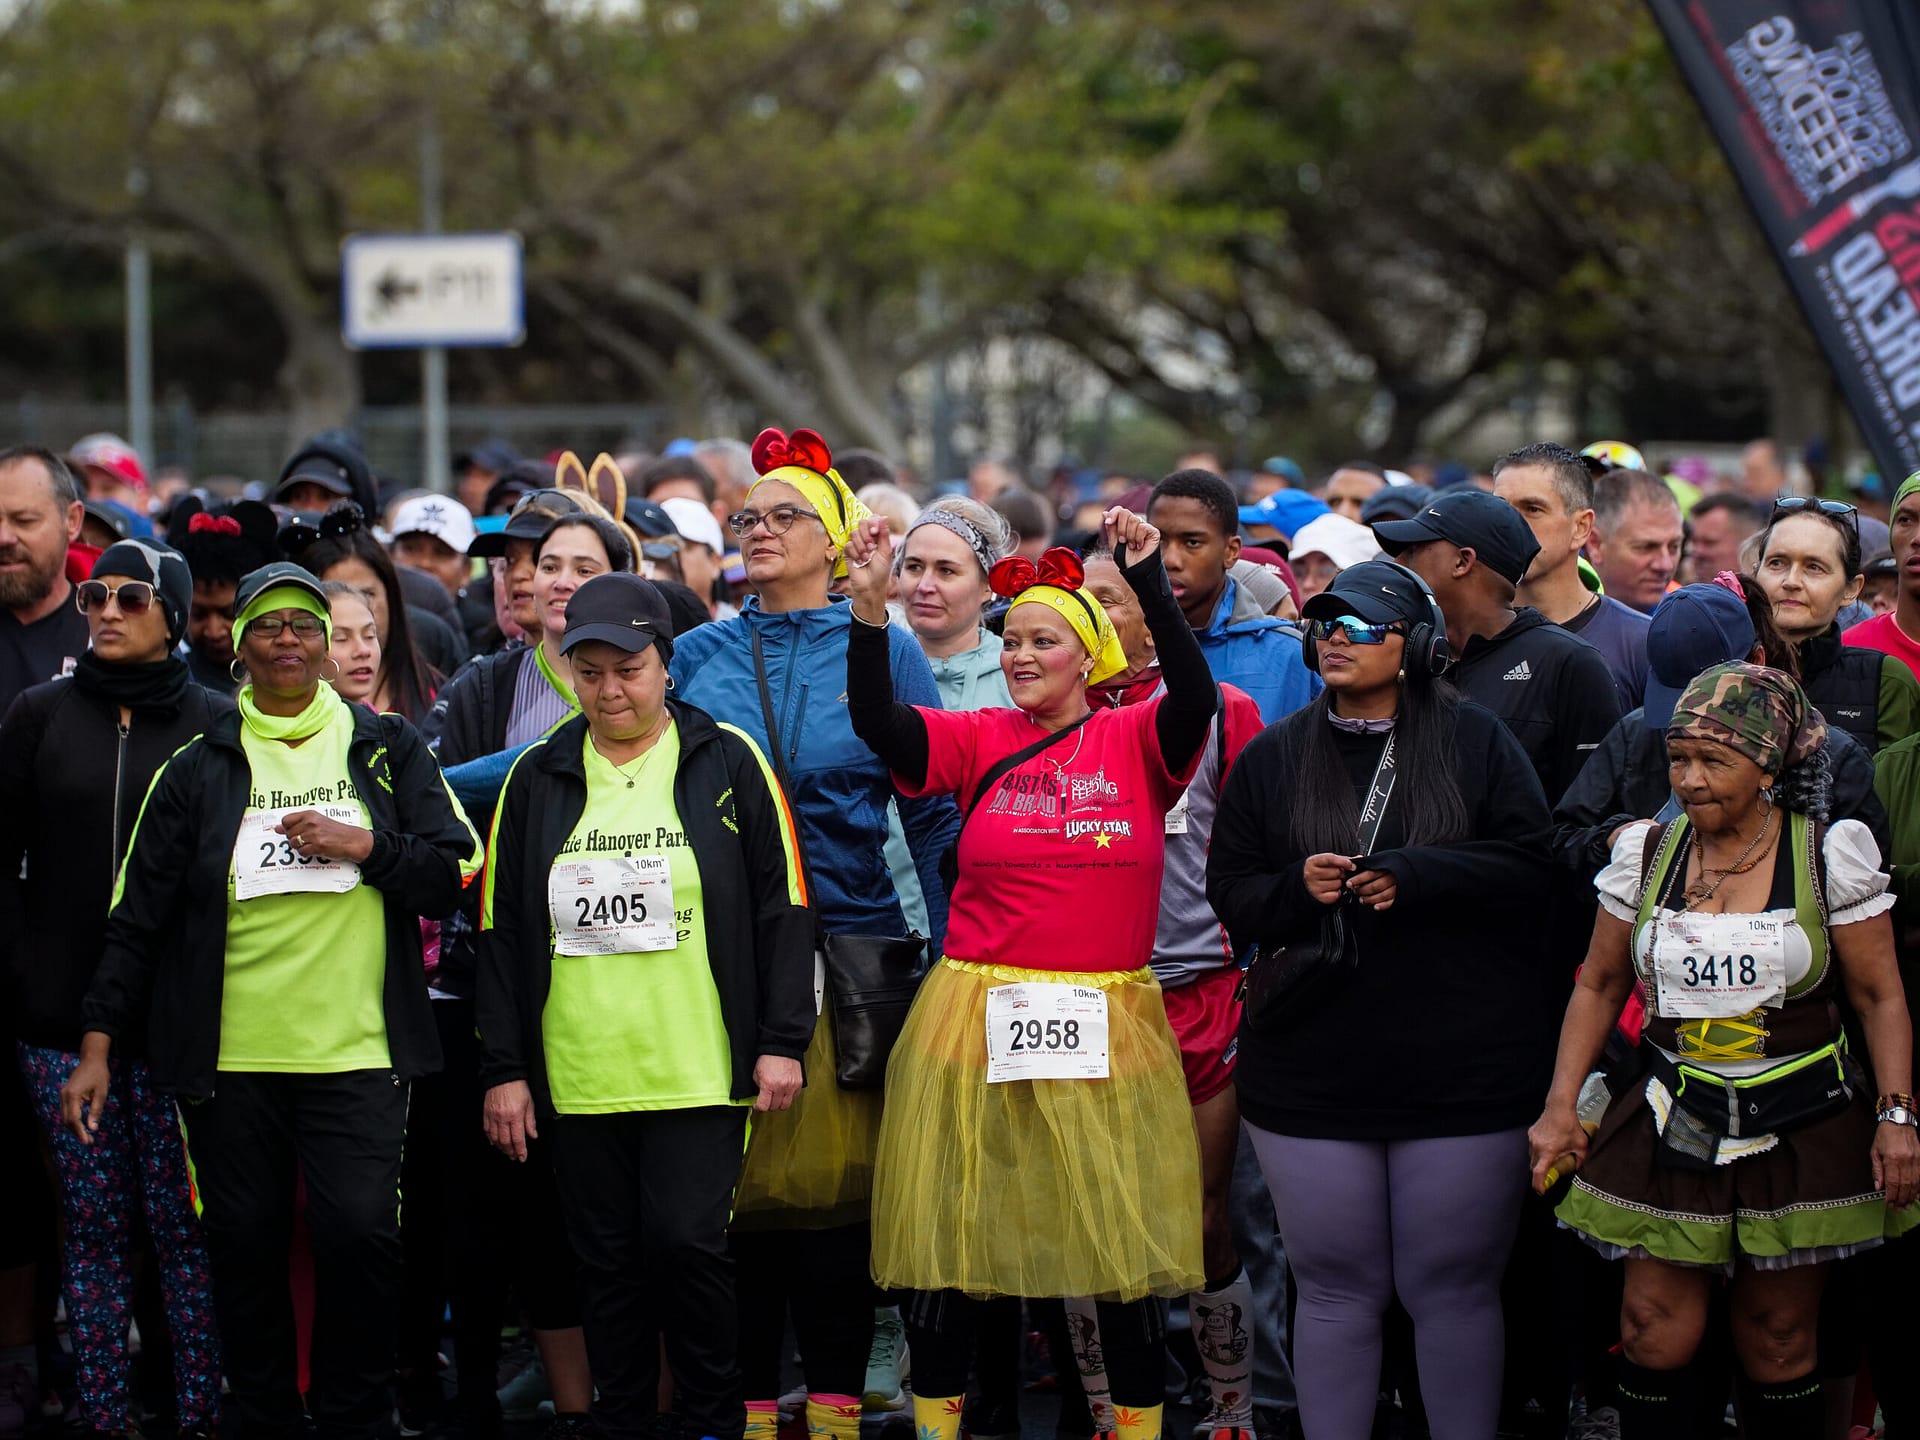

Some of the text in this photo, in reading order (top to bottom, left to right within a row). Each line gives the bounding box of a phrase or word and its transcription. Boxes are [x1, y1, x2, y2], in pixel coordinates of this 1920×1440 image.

[1503, 672, 1532, 680] adidas
[1382, 735, 1396, 770] uella
[270, 786, 333, 810] Hanover
[324, 808, 351, 818] 10km
[1066, 820, 1131, 838] LUCKY STAR
[585, 829, 651, 852] Hanover
[635, 858, 662, 871] 10km
[575, 893, 647, 927] 2405
[1749, 920, 1776, 931] 10km
[1682, 954, 1757, 987] 3418
[1073, 988, 1099, 999] 10km
[1010, 1019, 1080, 1051] 2958
